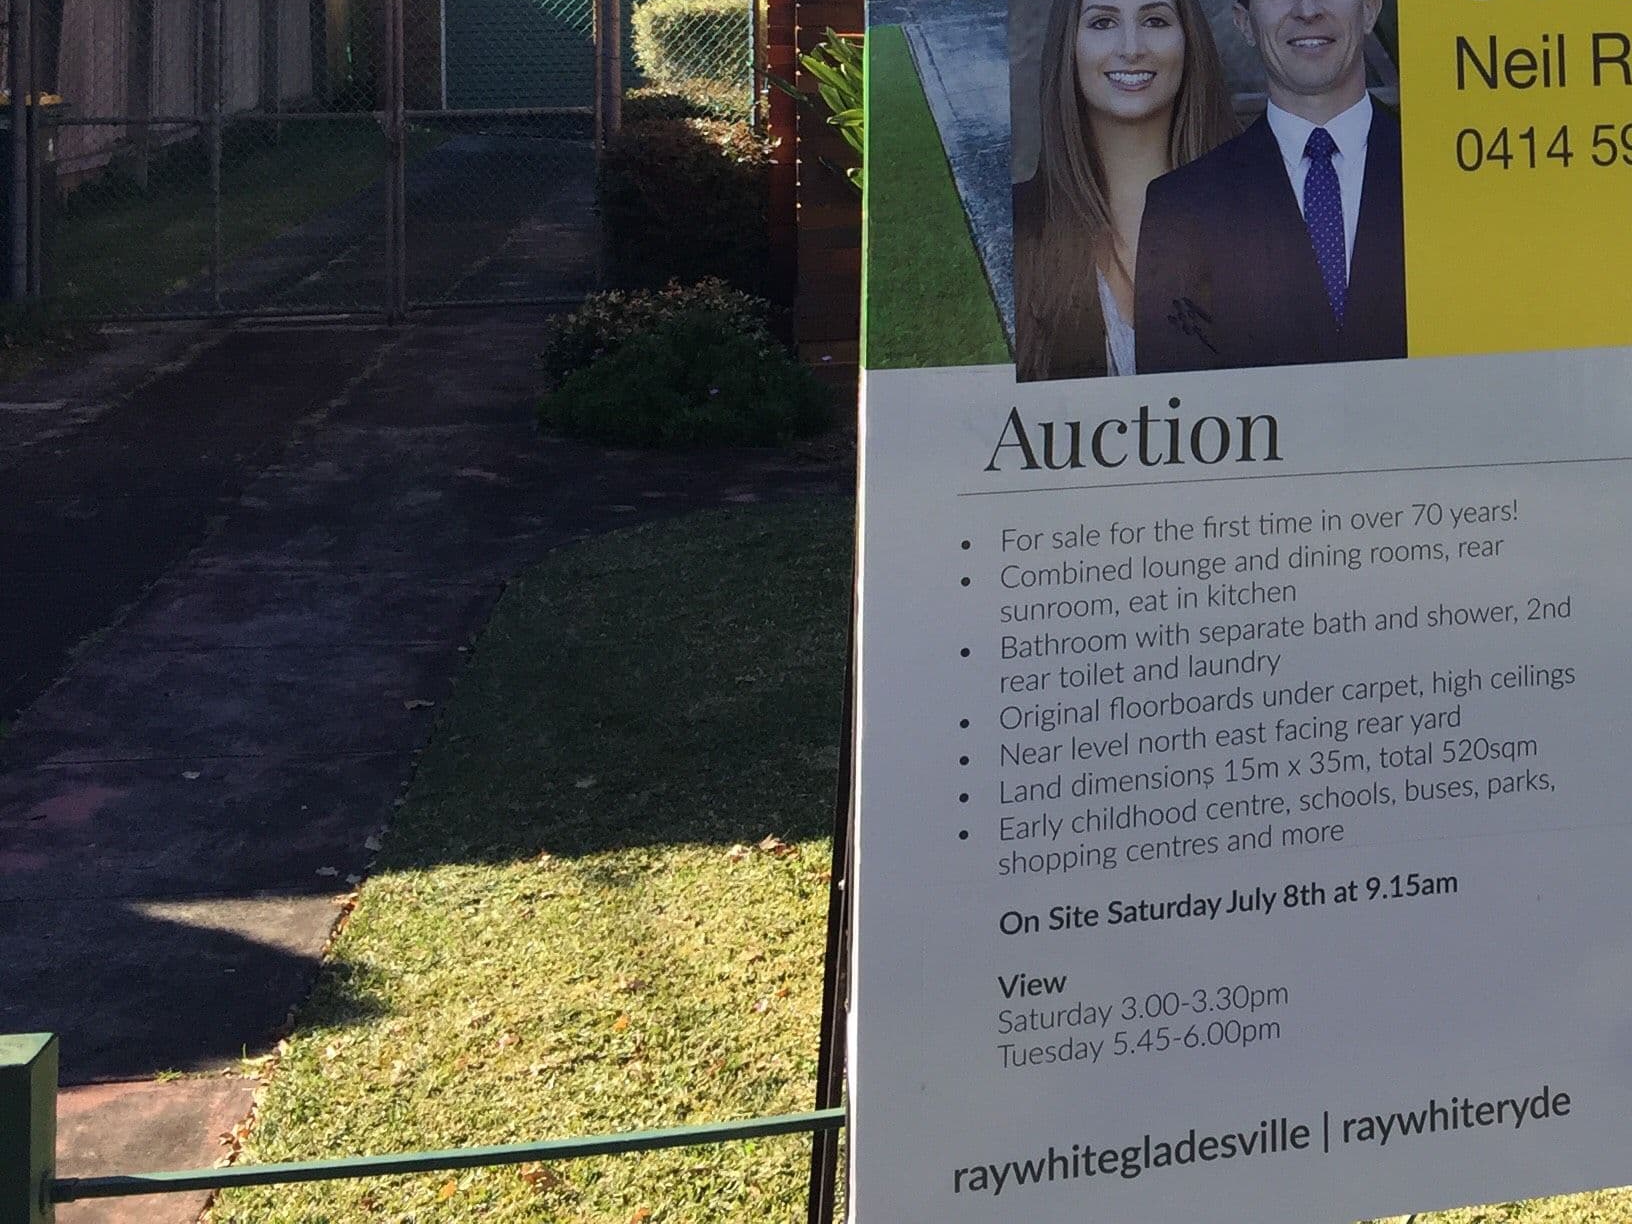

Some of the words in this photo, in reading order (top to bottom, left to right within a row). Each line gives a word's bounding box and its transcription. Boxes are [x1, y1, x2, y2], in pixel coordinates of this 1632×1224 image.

[1456, 33, 1566, 90] Neil
[1457, 125, 1574, 171] 0414
[984, 397, 1283, 472] Auction
[1002, 529, 1044, 552] For
[1052, 524, 1100, 549] sale
[1110, 522, 1145, 544] for
[1154, 519, 1194, 542] the
[1203, 515, 1250, 538] first
[1259, 513, 1312, 535] time
[1322, 509, 1341, 531] in
[1351, 511, 1403, 529] over
[1412, 503, 1442, 525] 70
[1450, 499, 1517, 529] years!
[1001, 557, 1132, 588] Combined
[1143, 556, 1226, 580] lounge
[1235, 547, 1278, 572] and
[1289, 545, 1361, 570] dining
[1371, 544, 1449, 564] rooms,
[1459, 540, 1504, 558] rear
[1001, 598, 1119, 622] sunroom,
[1129, 590, 1168, 613] eat
[1178, 587, 1197, 609] in
[1208, 581, 1296, 607] kitchen
[1002, 633, 1126, 659] Bathroom
[1136, 622, 1189, 648] with
[1200, 617, 1304, 646] separate
[1314, 610, 1365, 635] bath
[1375, 606, 1417, 631] and
[1428, 604, 1518, 627] shower,
[1528, 596, 1570, 620] 2nd
[1000, 698, 1099, 732] Original
[1110, 687, 1253, 720] floorboards
[1263, 681, 1334, 707] under
[1342, 674, 1423, 703] carpet,
[1433, 668, 1481, 697] high
[1491, 665, 1575, 690] ceilings
[1001, 673, 1051, 693] rear
[1059, 662, 1124, 688] toilet
[1133, 655, 1178, 682] and
[1188, 650, 1280, 678] laundry
[1001, 743, 1063, 767] Near
[1072, 732, 1128, 760] level
[1139, 726, 1206, 754] north
[1216, 722, 1267, 747] east
[1275, 716, 1348, 742] facing
[1358, 715, 1404, 735] rear
[1410, 704, 1460, 736] yard
[1001, 775, 1061, 804] Land
[1072, 765, 1214, 797] dimensions
[1225, 757, 1278, 782] 15m
[1288, 759, 1300, 776] x
[1310, 750, 1370, 774] 35m,
[1379, 742, 1432, 768] total
[1443, 738, 1537, 763] 520sqm
[1000, 813, 1063, 841] Early
[1072, 799, 1196, 833] childhood
[1206, 794, 1290, 820] centre,
[1300, 782, 1396, 811] schools,
[1406, 779, 1478, 801] buses,
[1488, 769, 1555, 799] parks,
[999, 844, 1117, 875] shopping
[1127, 836, 1218, 862] centres
[1228, 824, 1271, 852] and
[1283, 825, 1344, 846] more
[1000, 911, 1039, 935] On
[1049, 905, 1099, 930] Site
[1108, 893, 1222, 924] Saturday
[1226, 887, 1277, 915] July
[1283, 882, 1325, 907] 8th
[1334, 880, 1358, 903] at
[1366, 873, 1457, 900] 9.15am
[998, 973, 1067, 999] View
[998, 1002, 1112, 1034] Saturday
[1122, 985, 1288, 1020] 3.00-3.30pm
[997, 1037, 1104, 1068] Tuesday
[1114, 1020, 1280, 1055] 5.45-6.00pm
[955, 1118, 1310, 1196] raywhitegladesville
[1344, 1085, 1570, 1146] raywhiteryde
